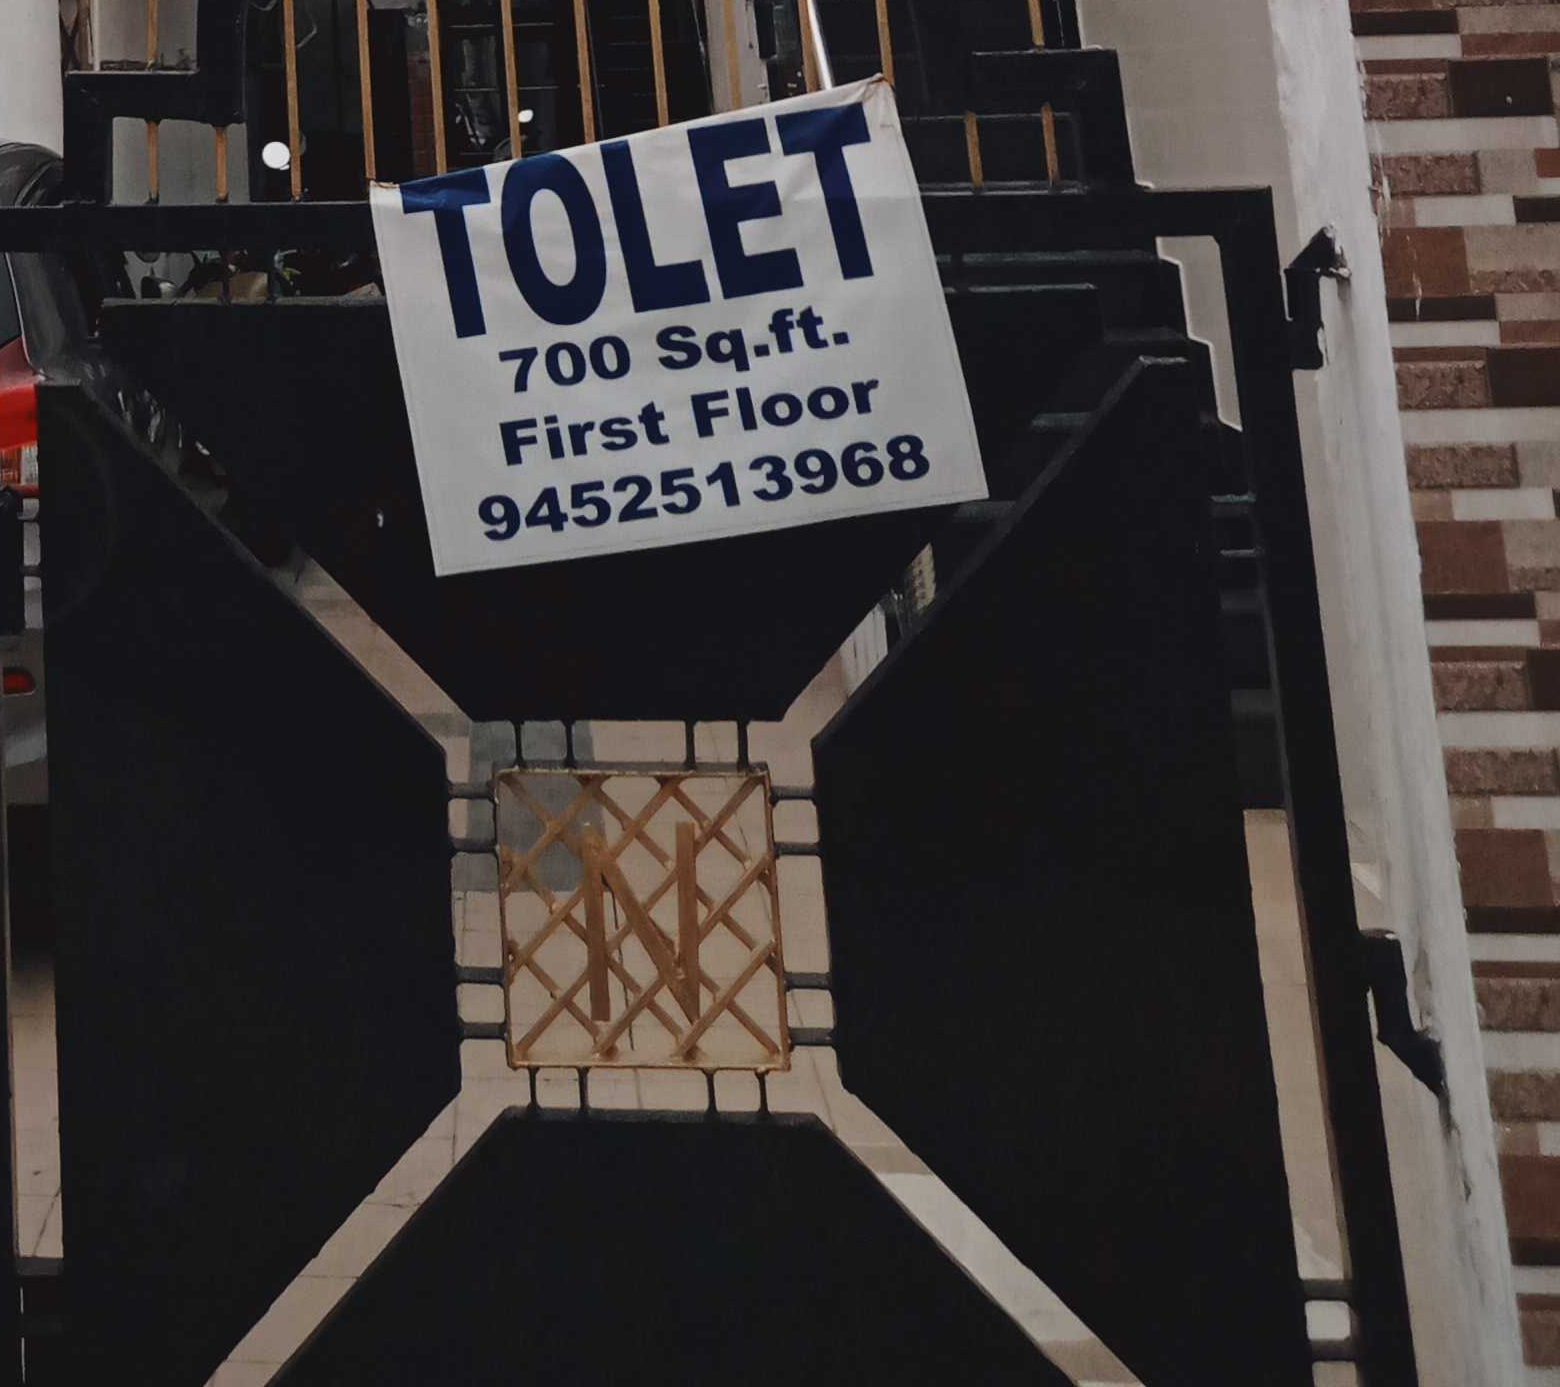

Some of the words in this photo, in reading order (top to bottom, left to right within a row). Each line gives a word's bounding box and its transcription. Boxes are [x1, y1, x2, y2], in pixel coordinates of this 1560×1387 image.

[400, 103, 873, 338] TOLET
[499, 336, 630, 393] 700
[657, 306, 849, 371] Sq.ft.
[499, 401, 670, 465] First
[690, 379, 879, 438] Floor
[478, 434, 930, 541] 9452513968
